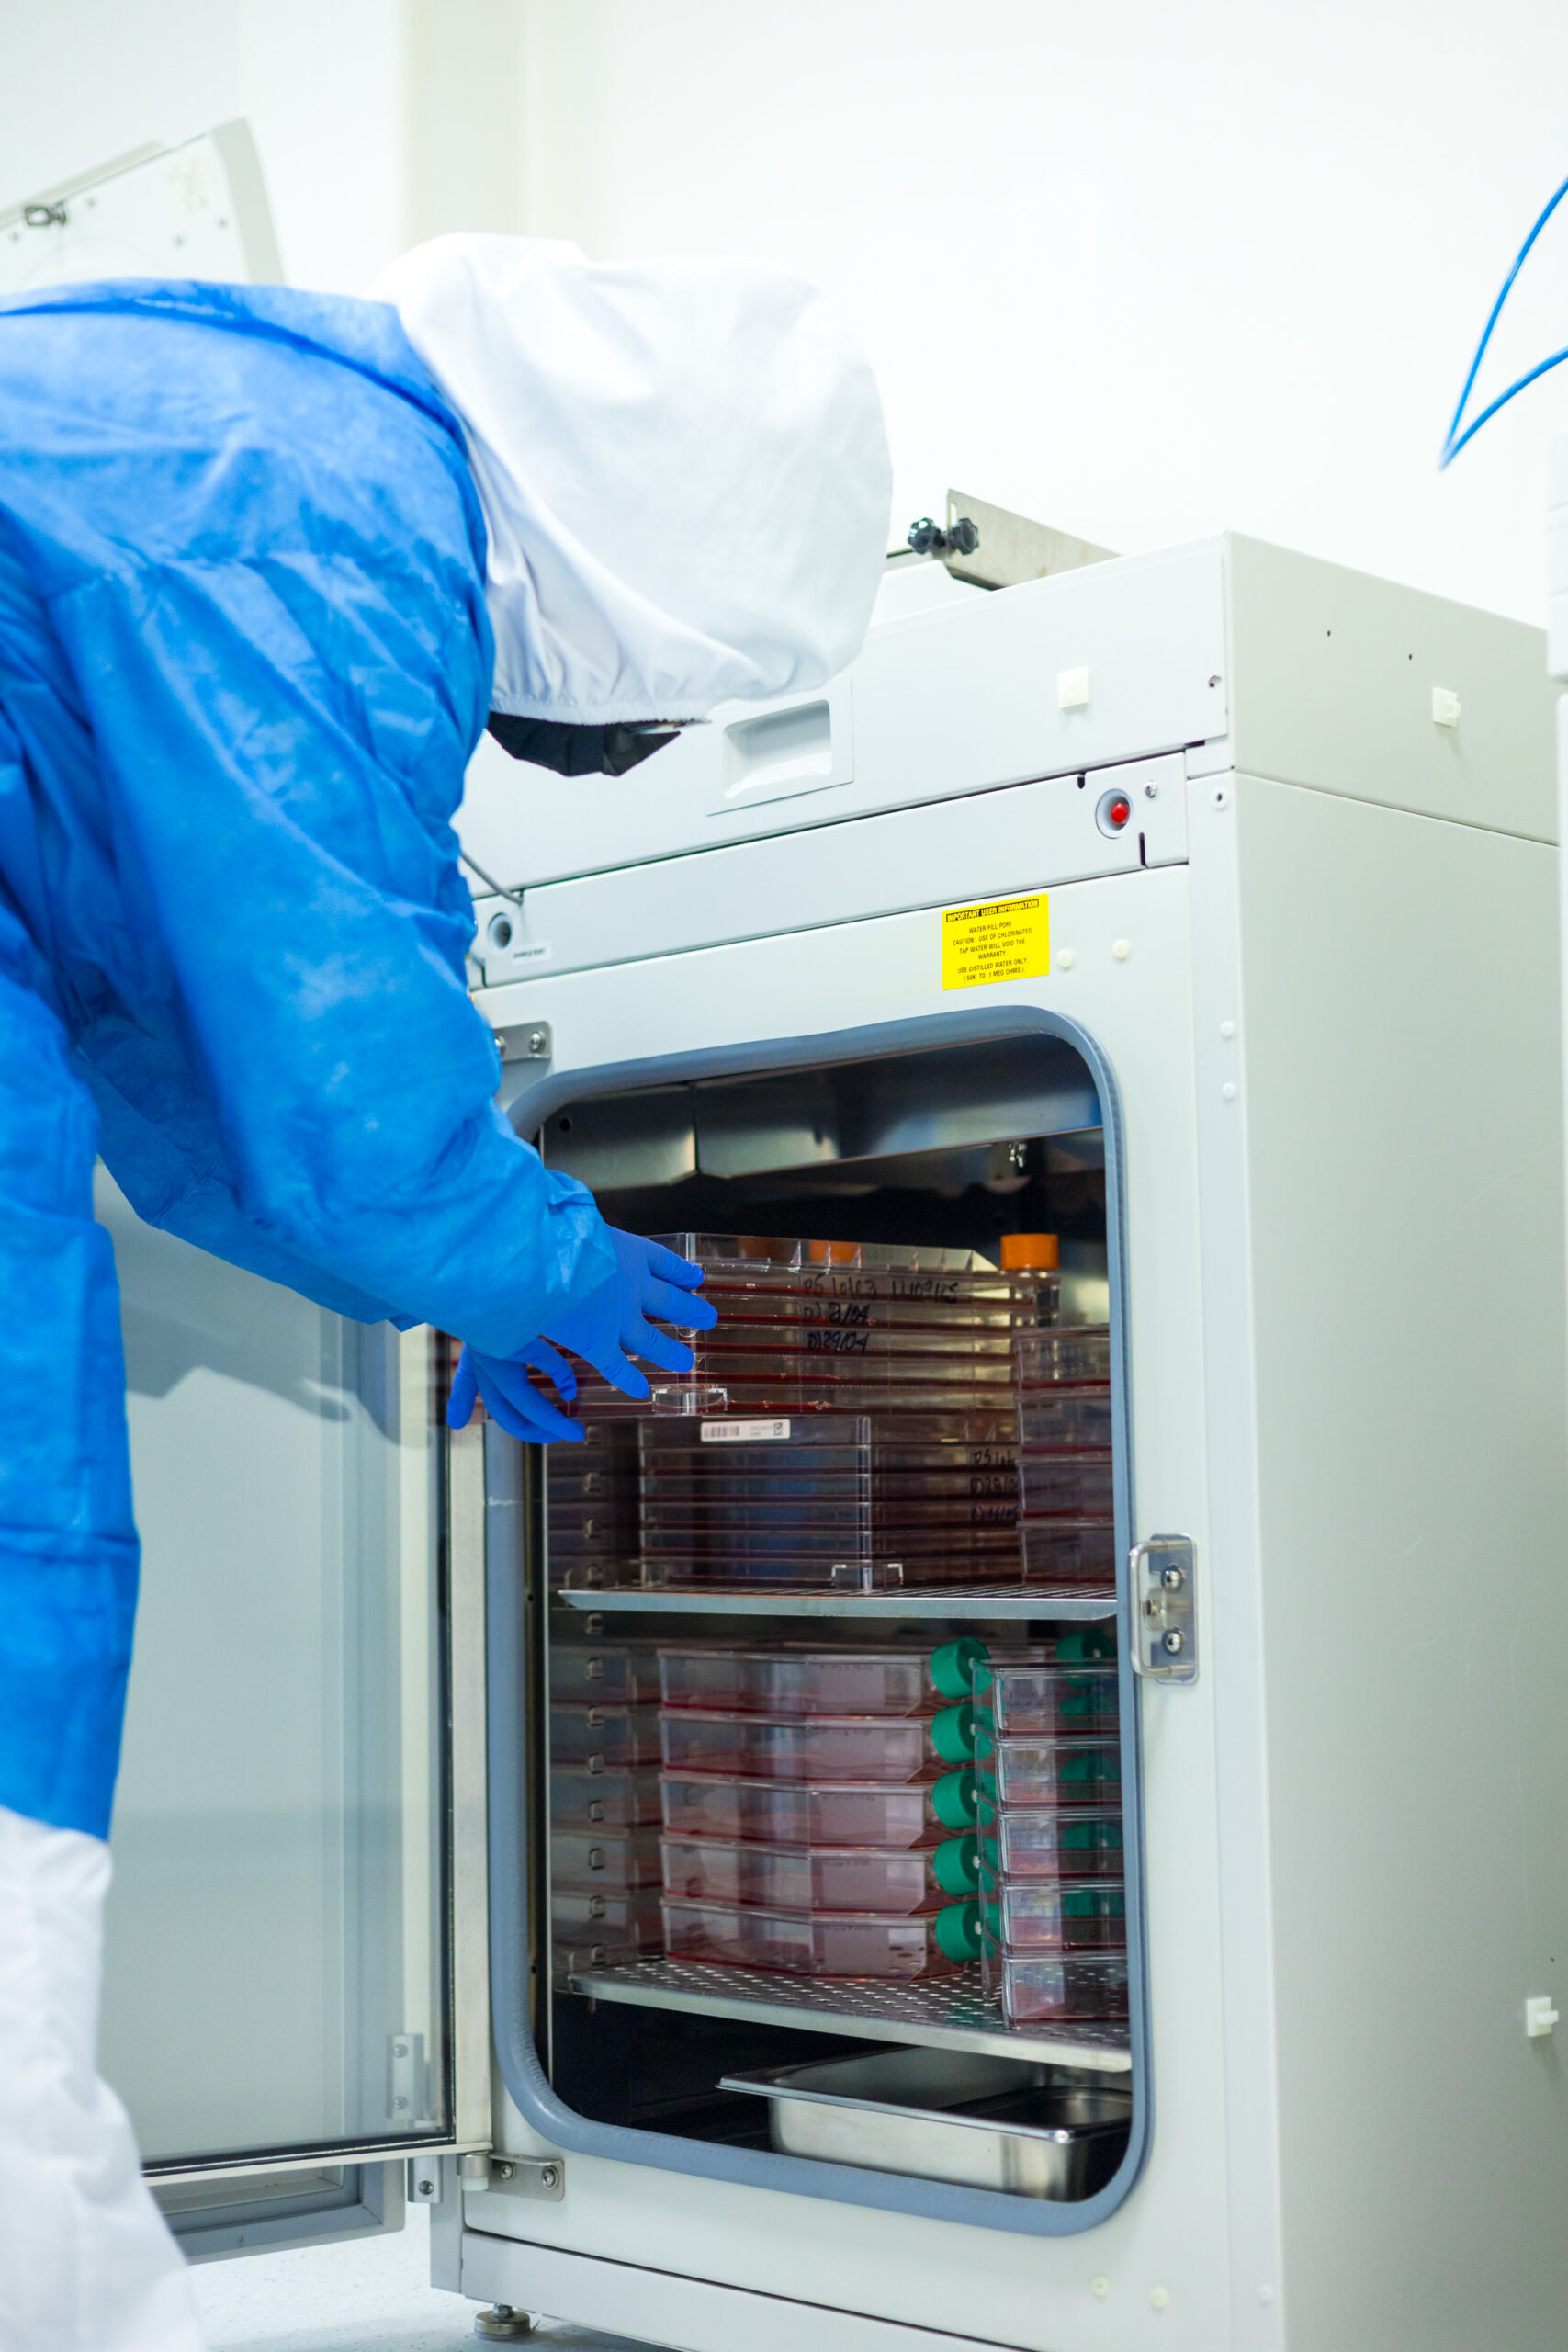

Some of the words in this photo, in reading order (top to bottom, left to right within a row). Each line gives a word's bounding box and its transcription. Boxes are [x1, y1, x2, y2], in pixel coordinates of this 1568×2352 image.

[947, 910, 980, 922] IMPORTANT
[980, 907, 998, 917] USER
[998, 899, 1038, 914] INFORMATION
[969, 925, 987, 933] WATER
[987, 922, 998, 931] FILL
[999, 921, 1012, 929] PORT
[998, 927, 1032, 939] CHLORINATED
[970, 944, 987, 954] WATER
[988, 942, 1000, 950] WILL
[1002, 940, 1014, 948] VOID
[968, 962, 994, 972] DISTILLED
[995, 959, 1012, 968] WATER
[1005, 967, 1021, 975] OHMS
